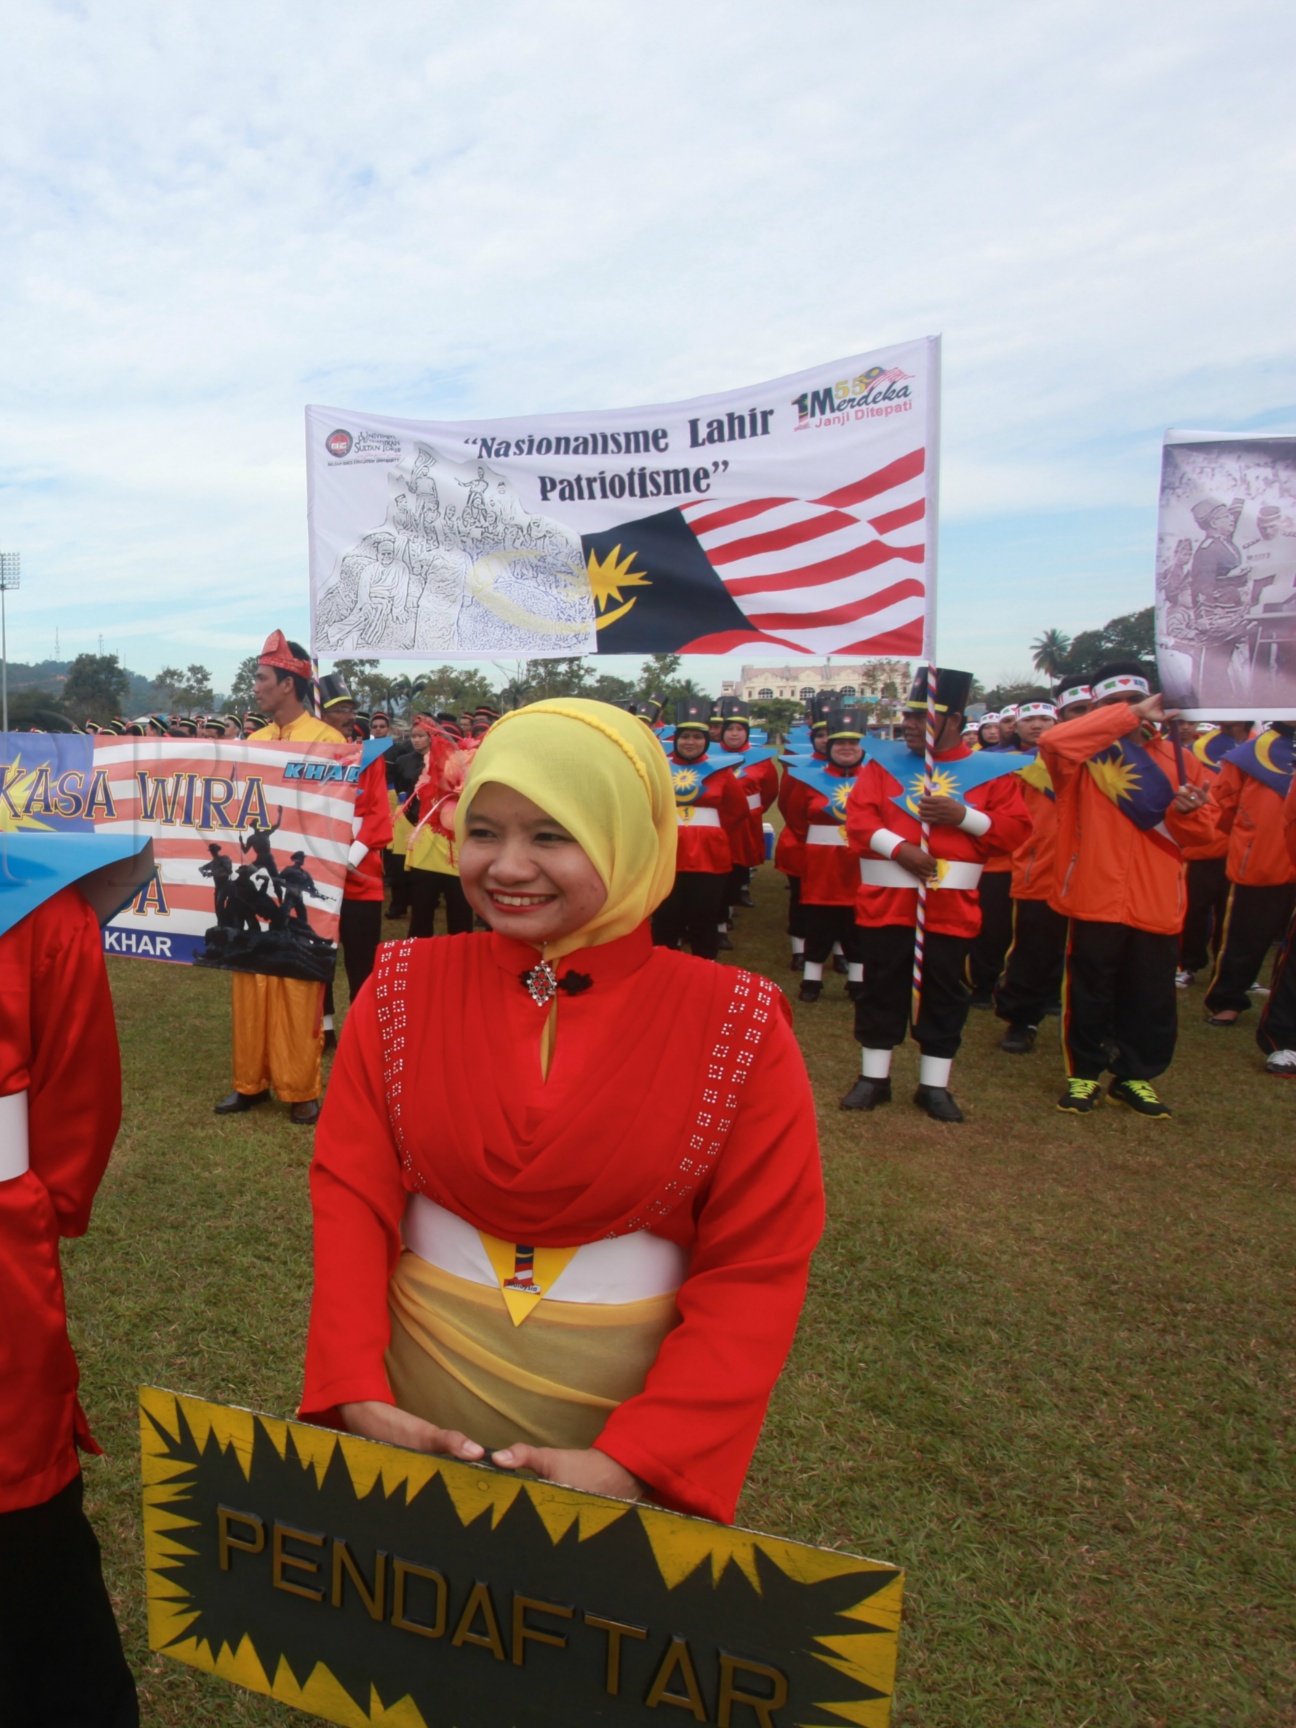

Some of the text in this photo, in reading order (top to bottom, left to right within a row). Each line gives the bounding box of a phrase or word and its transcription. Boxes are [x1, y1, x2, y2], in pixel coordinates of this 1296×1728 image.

[688, 407, 775, 449] Lahir
[815, 412, 850, 429] Janji
[855, 400, 912, 421] Ditepati
[136, 769, 271, 832] WIRA
[104, 930, 172, 957] KHAR
[217, 1503, 790, 1728] PENDAFTAR
